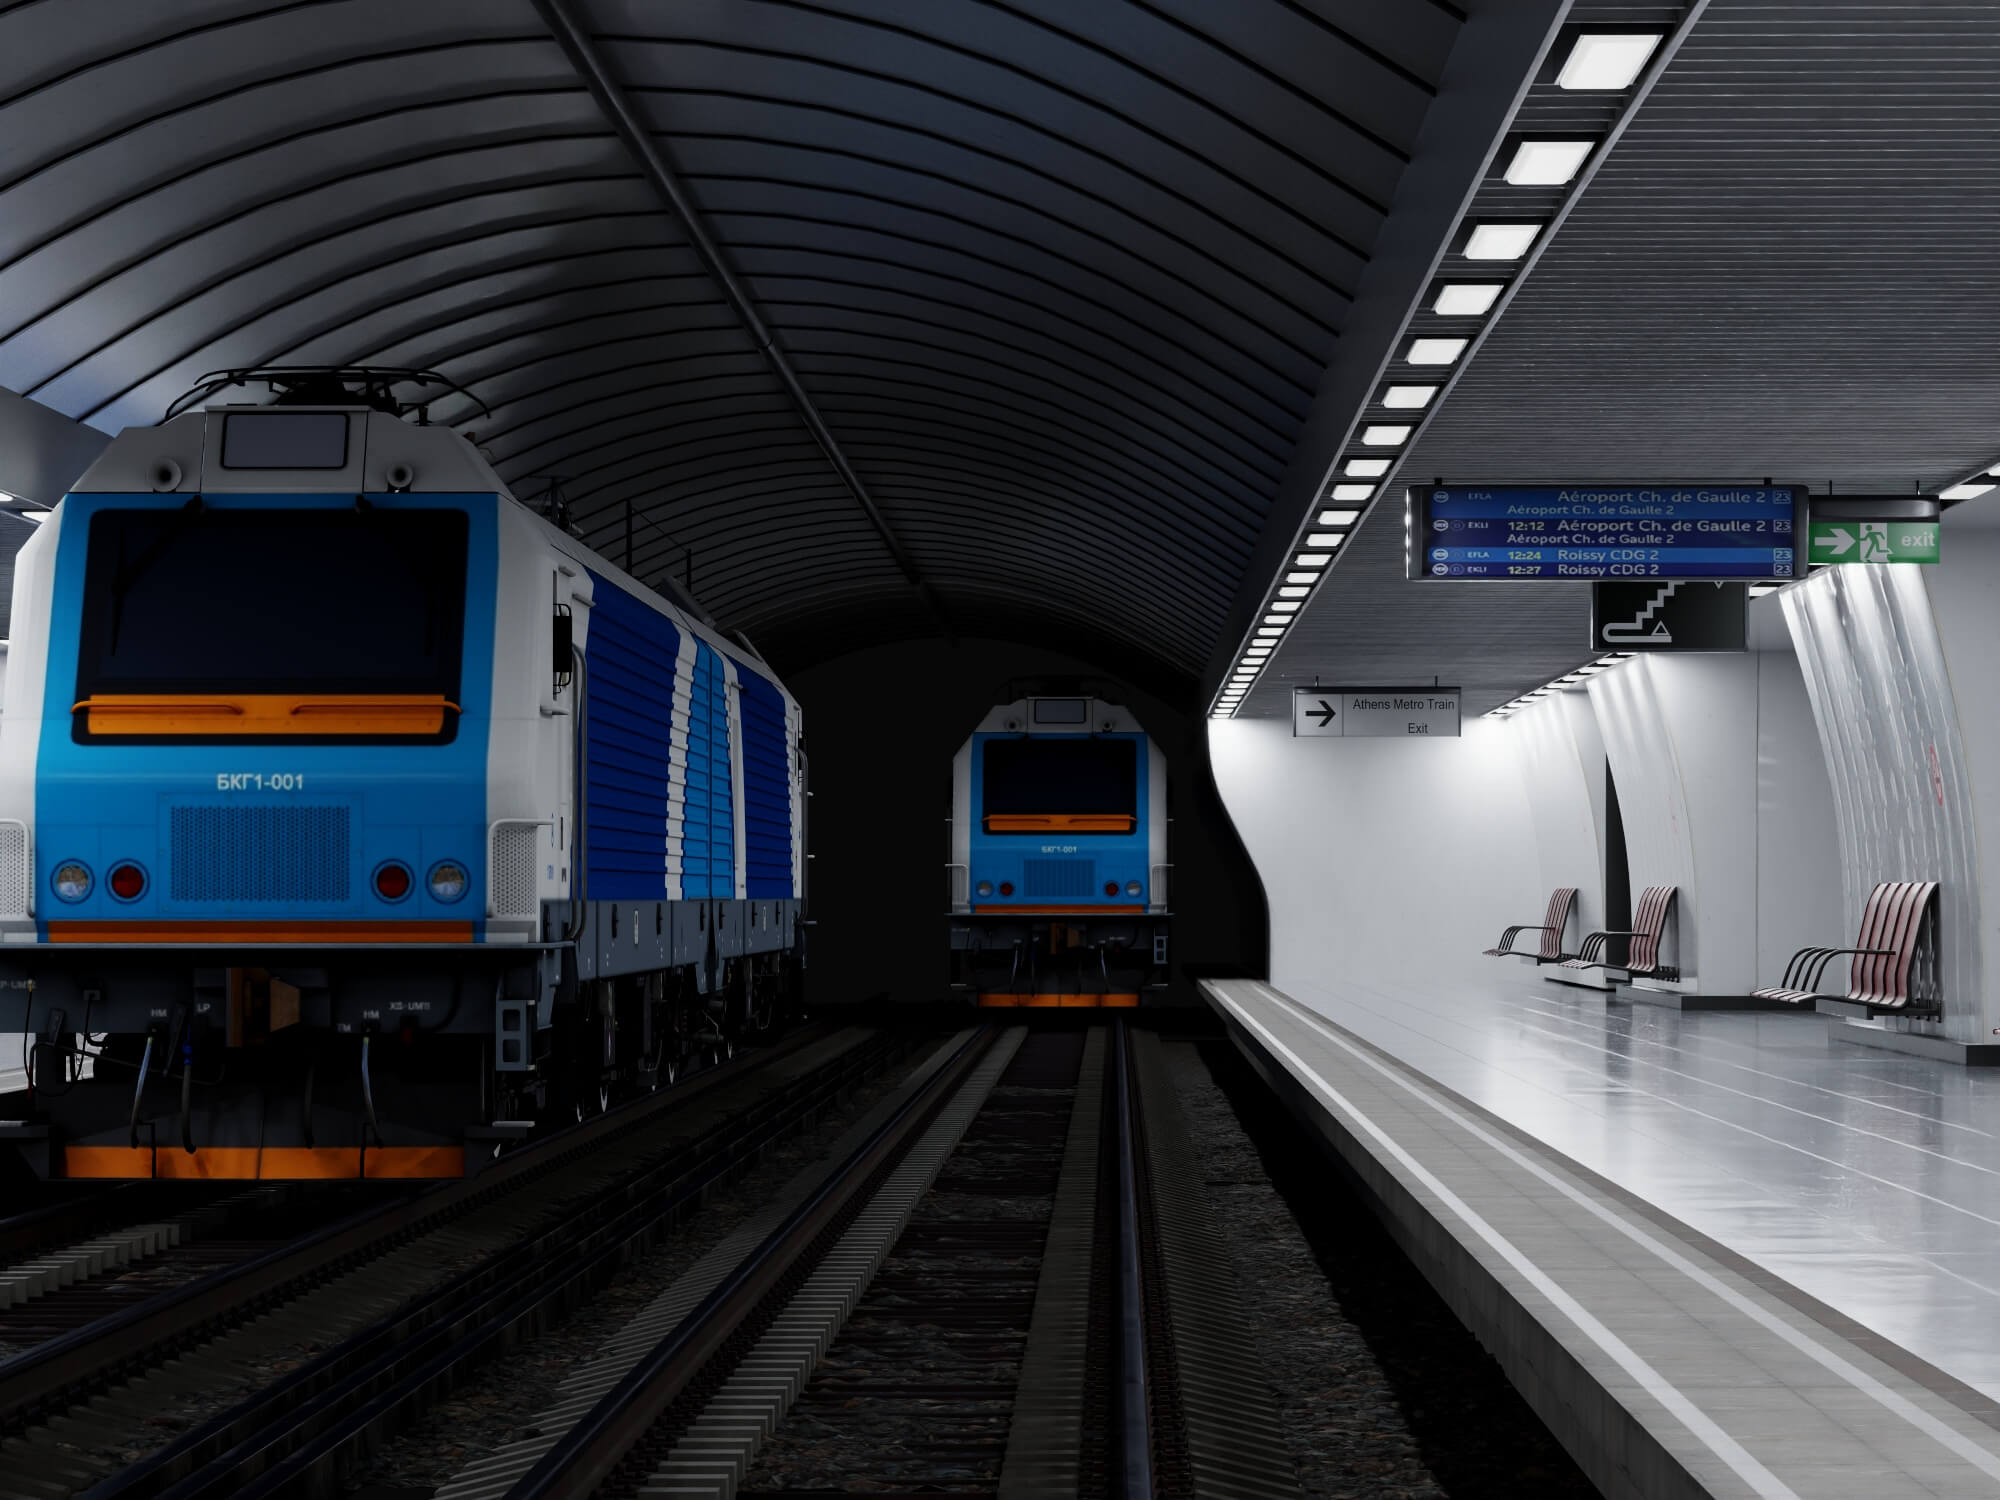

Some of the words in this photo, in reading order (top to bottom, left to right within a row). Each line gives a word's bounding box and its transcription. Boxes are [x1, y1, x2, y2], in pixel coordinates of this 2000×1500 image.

[1557, 491, 1634, 504] Aéroport
[1639, 491, 1667, 503] Ch.
[1671, 491, 1692, 503] de
[1696, 491, 1751, 503] Gaulle
[1756, 492, 1766, 503] 2
[1507, 505, 1569, 516] Aéroport
[1572, 505, 1595, 515] Ch.
[1599, 505, 1616, 515] de
[1619, 505, 1662, 515] Gaulle
[1666, 505, 1675, 515] 2
[1508, 521, 1545, 531] 12:12
[1557, 520, 1634, 533] Aéroport
[1639, 520, 1667, 532] Ch.
[1671, 520, 1692, 532] de
[1696, 520, 1751, 532] Gaulle
[1756, 521, 1766, 532] 2
[1775, 521, 1791, 531] 23
[1507, 534, 1569, 545] Aéroport
[1572, 534, 1595, 544] Ch.
[1599, 534, 1616, 544] de
[1619, 534, 1662, 544] Gaulle
[1666, 534, 1675, 544] 2
[1901, 532, 1935, 547] exit
[1508, 551, 1541, 560] 12:24
[1557, 550, 1606, 562] Roissy
[1610, 550, 1645, 560] CDG
[1650, 550, 1659, 560] 2
[1775, 551, 1792, 559] 23
[1508, 566, 1541, 575] 12:27
[1557, 564, 1606, 577] Roissy
[1610, 564, 1646, 575] CDG
[1650, 565, 1659, 575] 2
[1775, 565, 1792, 574] 23
[1353, 699, 1391, 710] Athens
[1394, 699, 1424, 710] Metro
[1427, 699, 1454, 710] Train
[1408, 723, 1428, 734] Exit
[217, 773, 303, 791] БКГ1-001
